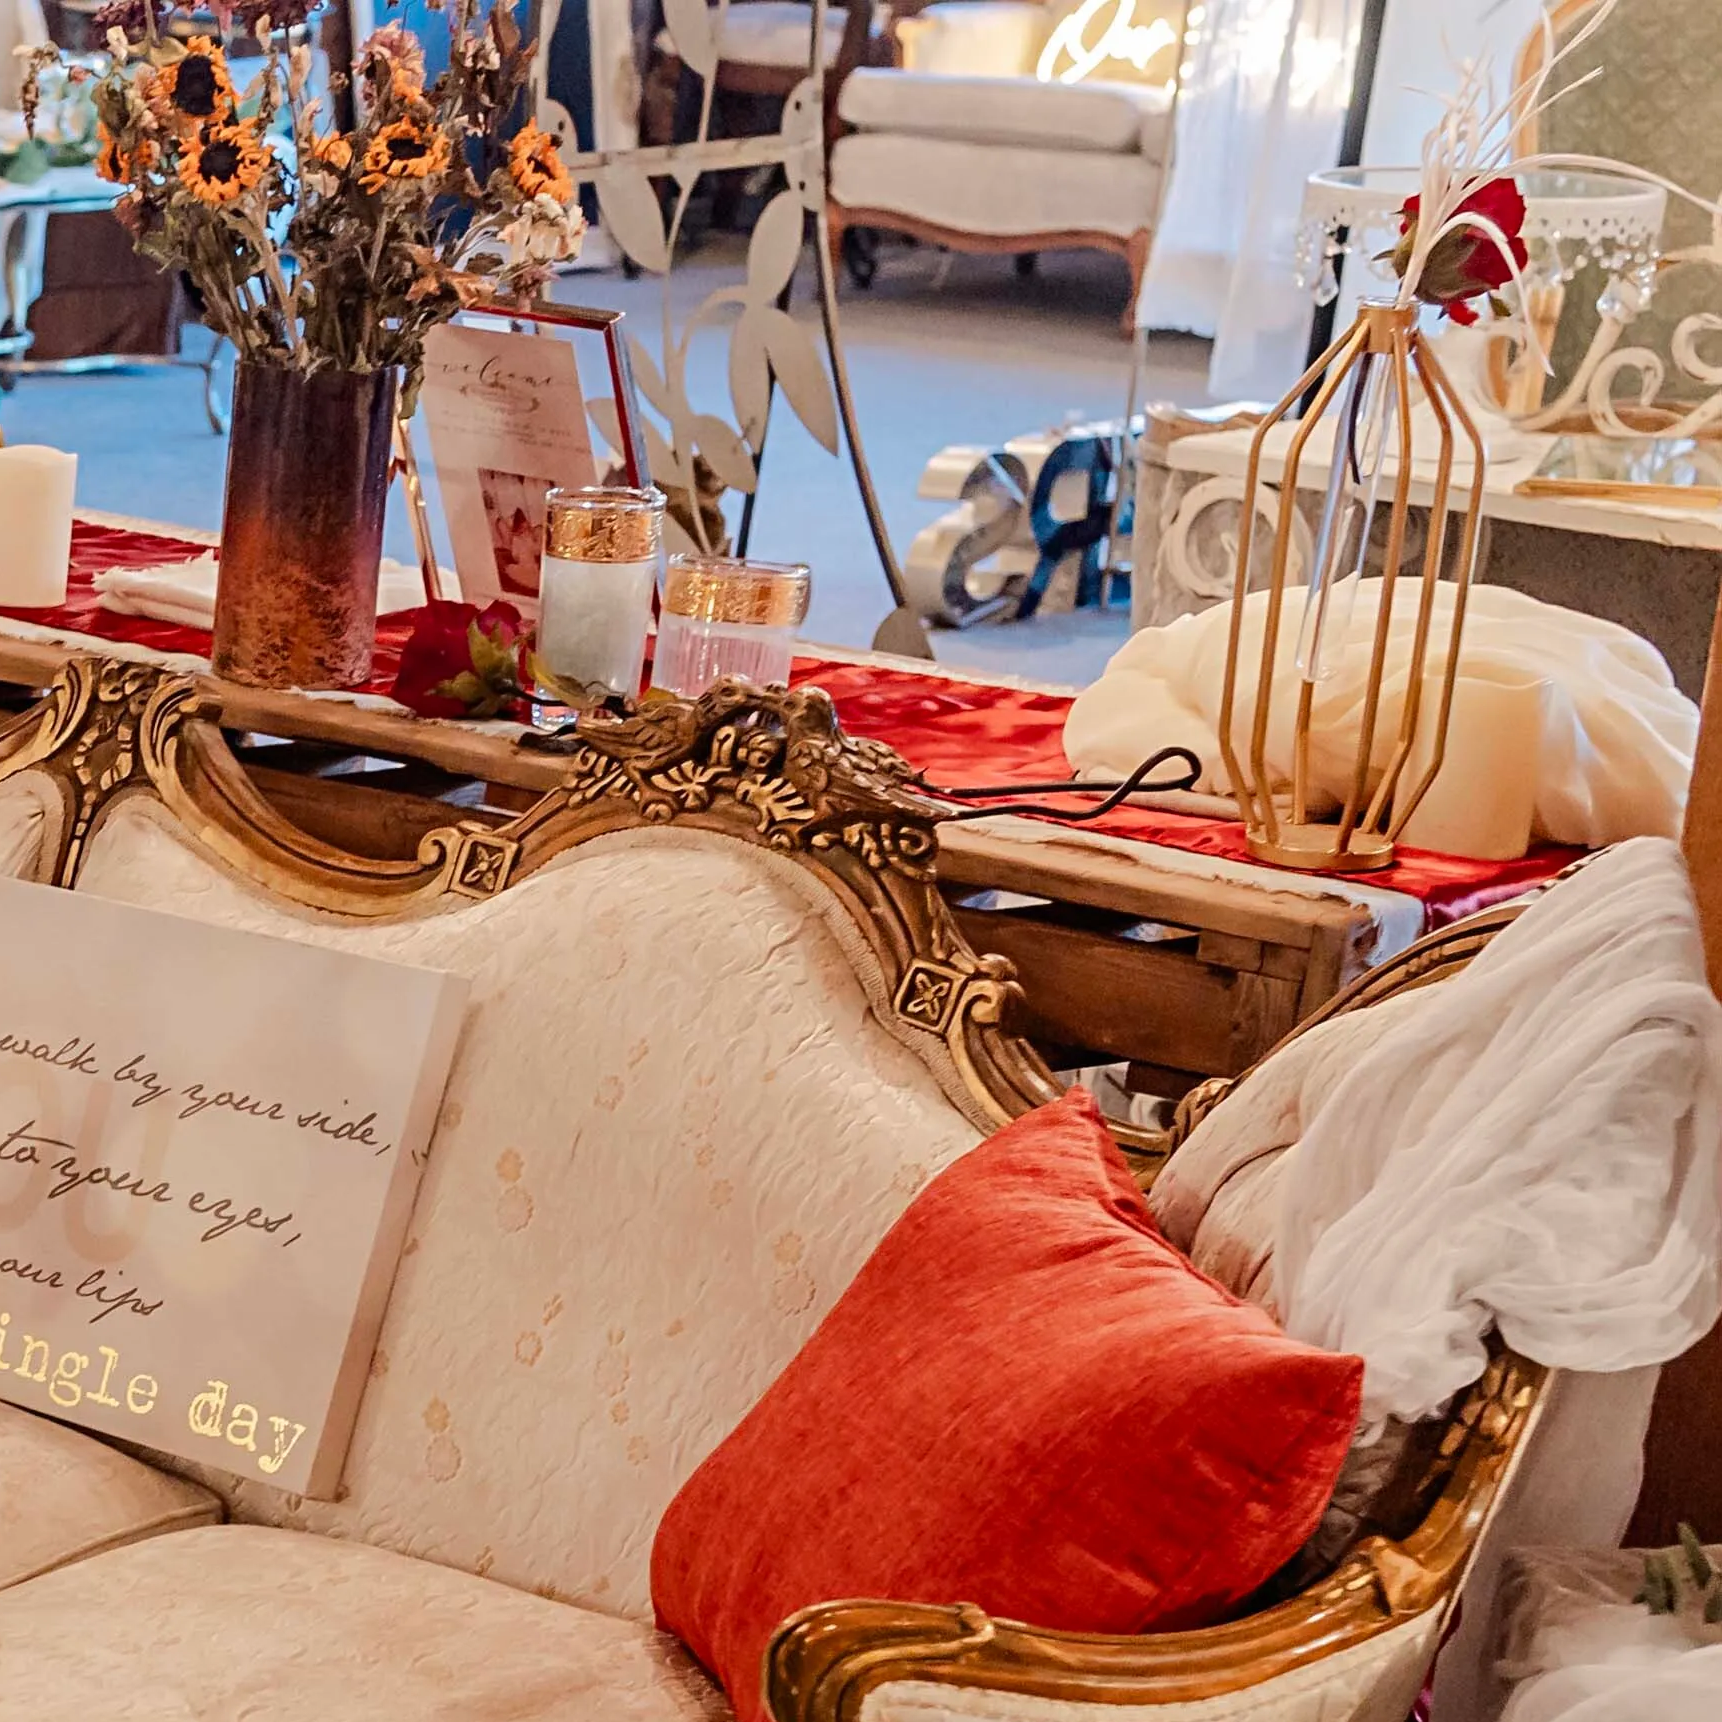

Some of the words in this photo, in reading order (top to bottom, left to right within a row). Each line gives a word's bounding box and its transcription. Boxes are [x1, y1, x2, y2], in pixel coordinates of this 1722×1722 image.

[114, 1054, 171, 1108] by
[179, 1083, 285, 1119] your
[296, 1099, 391, 1156] side,
[47, 1148, 173, 1200] your
[189, 1191, 302, 1248] eyes,
[74, 1270, 164, 1324] lips
[187, 1380, 307, 1475] day
